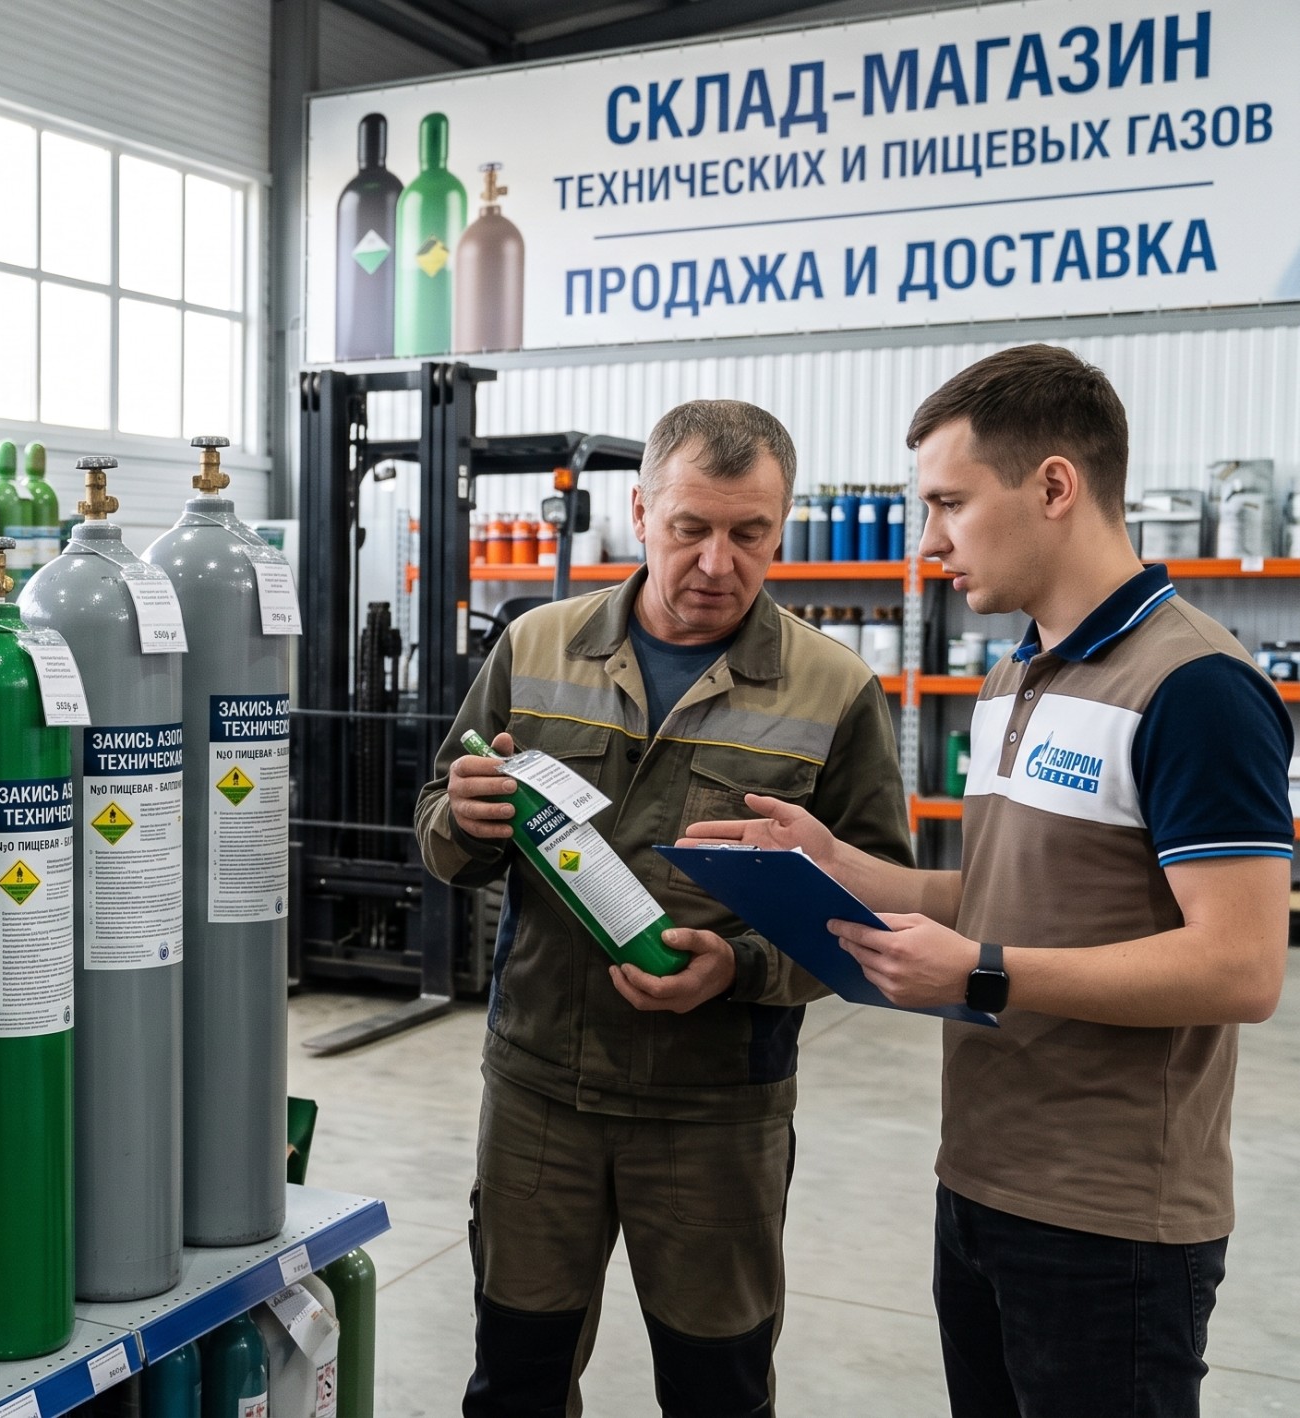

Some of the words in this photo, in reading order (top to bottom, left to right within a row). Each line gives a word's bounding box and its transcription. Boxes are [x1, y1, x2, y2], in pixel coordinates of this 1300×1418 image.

[606, 10, 1212, 146] СКЛАД-МАГАЗИН
[553, 148, 827, 211] ТЕХНИЧЕСКИХ
[841, 144, 867, 183] И
[882, 117, 1112, 179] ПИЩЕВЫХ
[1126, 101, 1274, 156] ГАЗОВ
[564, 249, 825, 319] ПРОДАЖА
[844, 245, 878, 298] И
[897, 216, 1218, 303] ДОСТАВКА
[93, 732, 153, 749] ЗАКИСЬ
[219, 701, 273, 717] ЗАКИСЬ
[1045, 747, 1103, 777] ГАЗПРОМ
